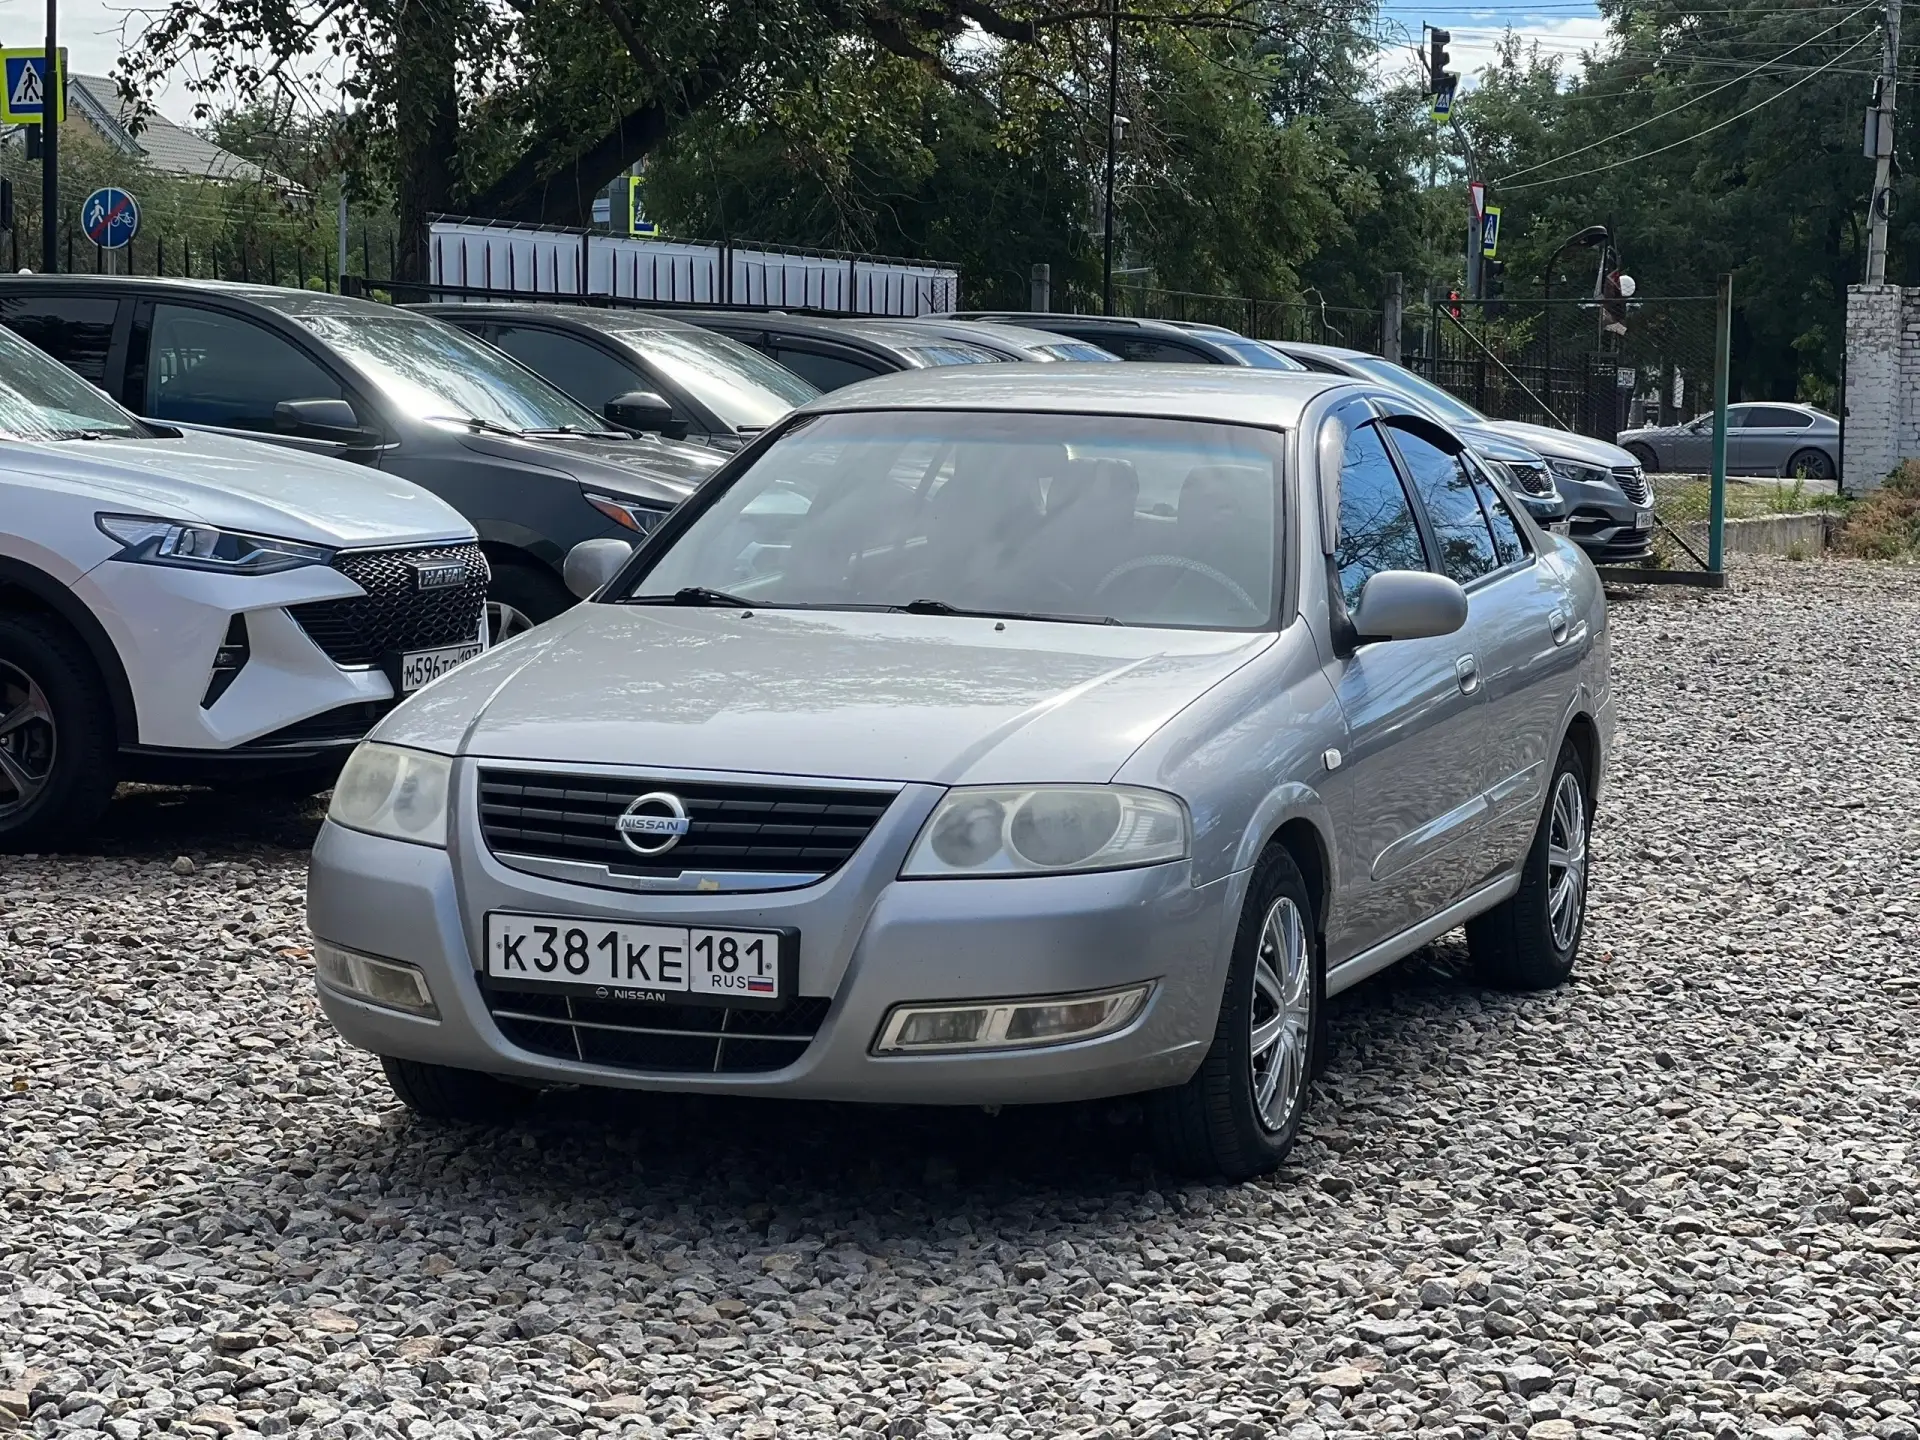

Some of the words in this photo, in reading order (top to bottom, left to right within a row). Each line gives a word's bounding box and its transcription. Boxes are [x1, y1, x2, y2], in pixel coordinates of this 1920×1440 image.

[424, 568, 465, 585] HAVAL
[620, 818, 679, 831] NISSAN
[695, 935, 764, 976] 181
[712, 974, 747, 989] RUS
[614, 989, 666, 1002] NISSAN
